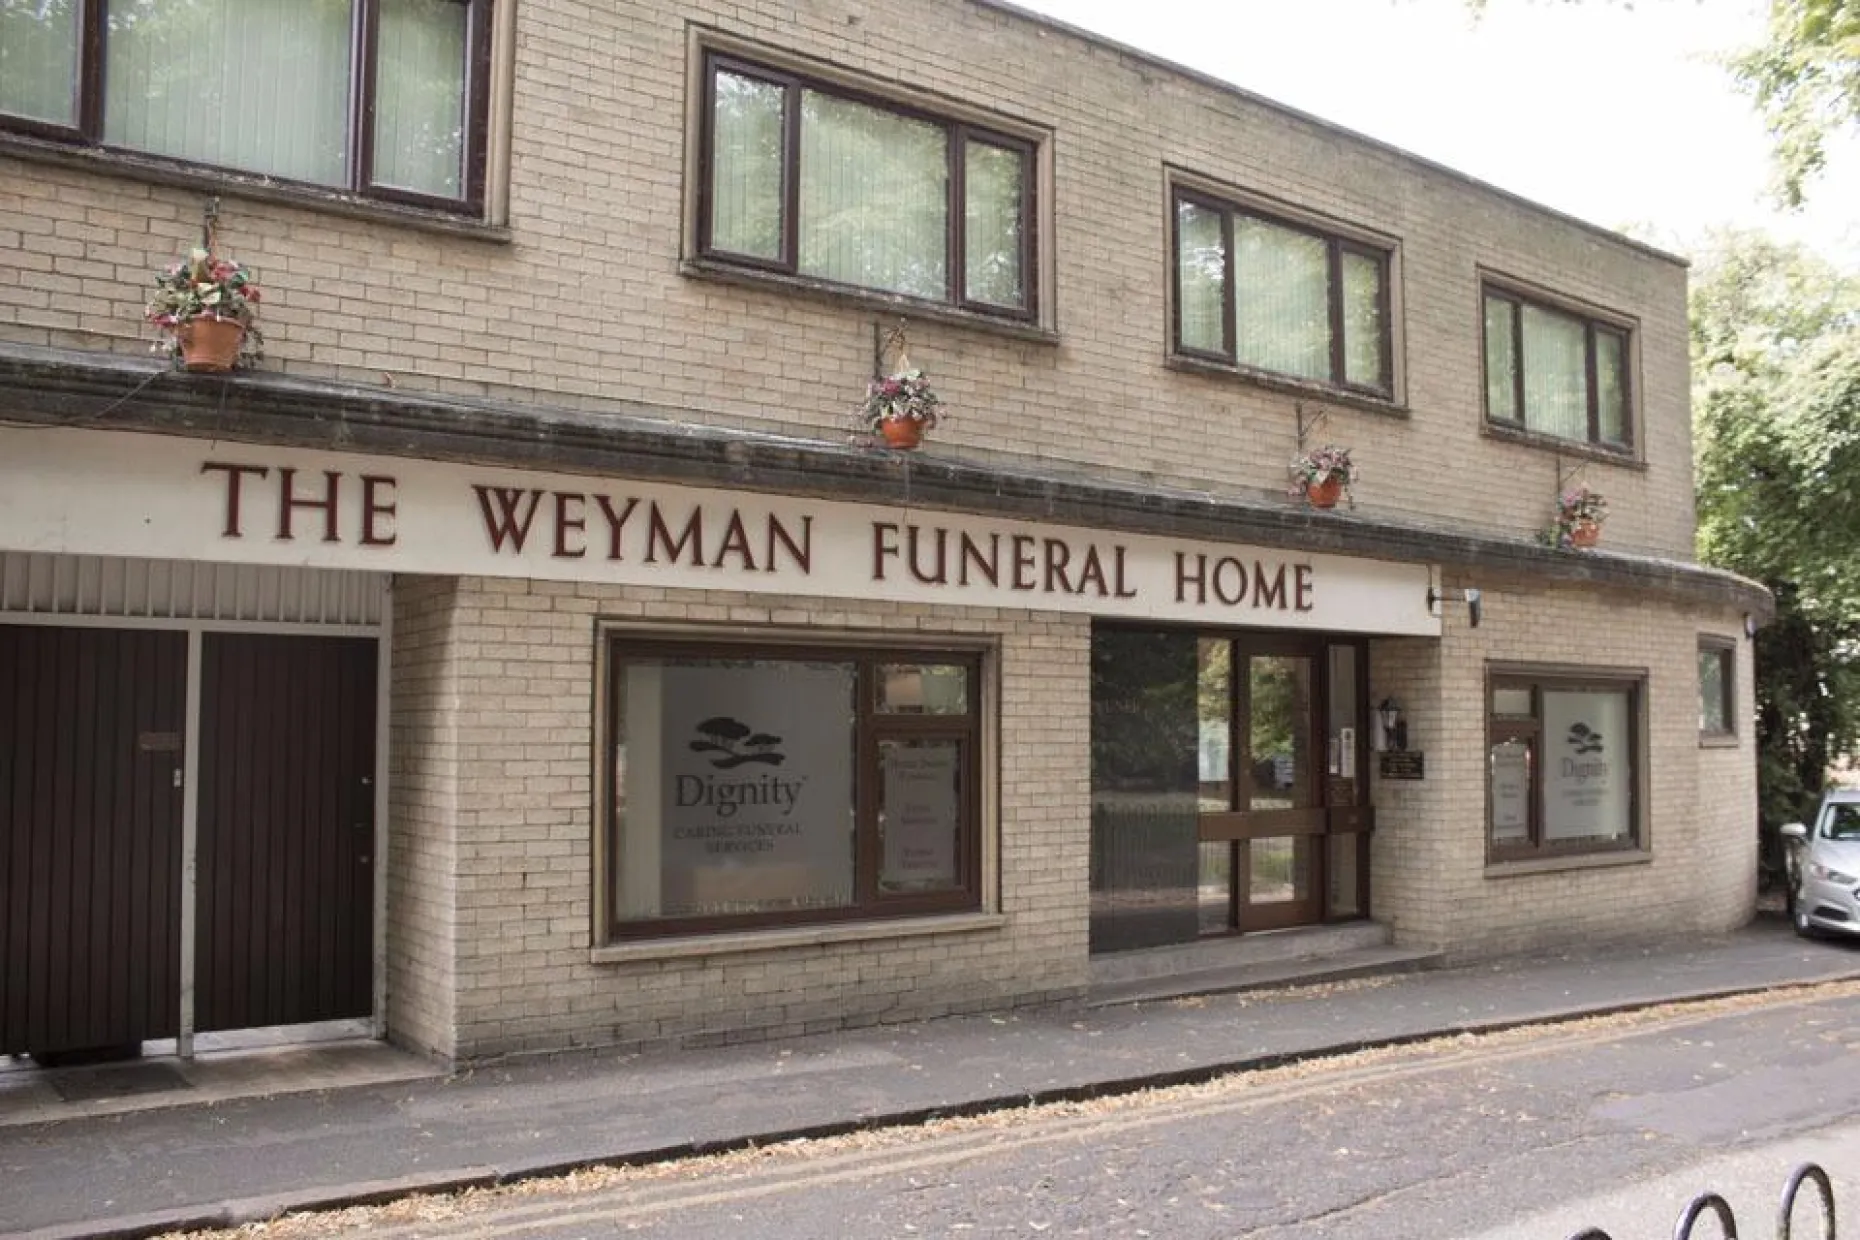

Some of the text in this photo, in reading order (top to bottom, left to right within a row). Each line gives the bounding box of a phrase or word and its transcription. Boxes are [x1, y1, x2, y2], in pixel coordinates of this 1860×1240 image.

[200, 461, 1314, 611] THE WEYMAN FUNERAL HOME
[675, 774, 803, 818] Dignity
